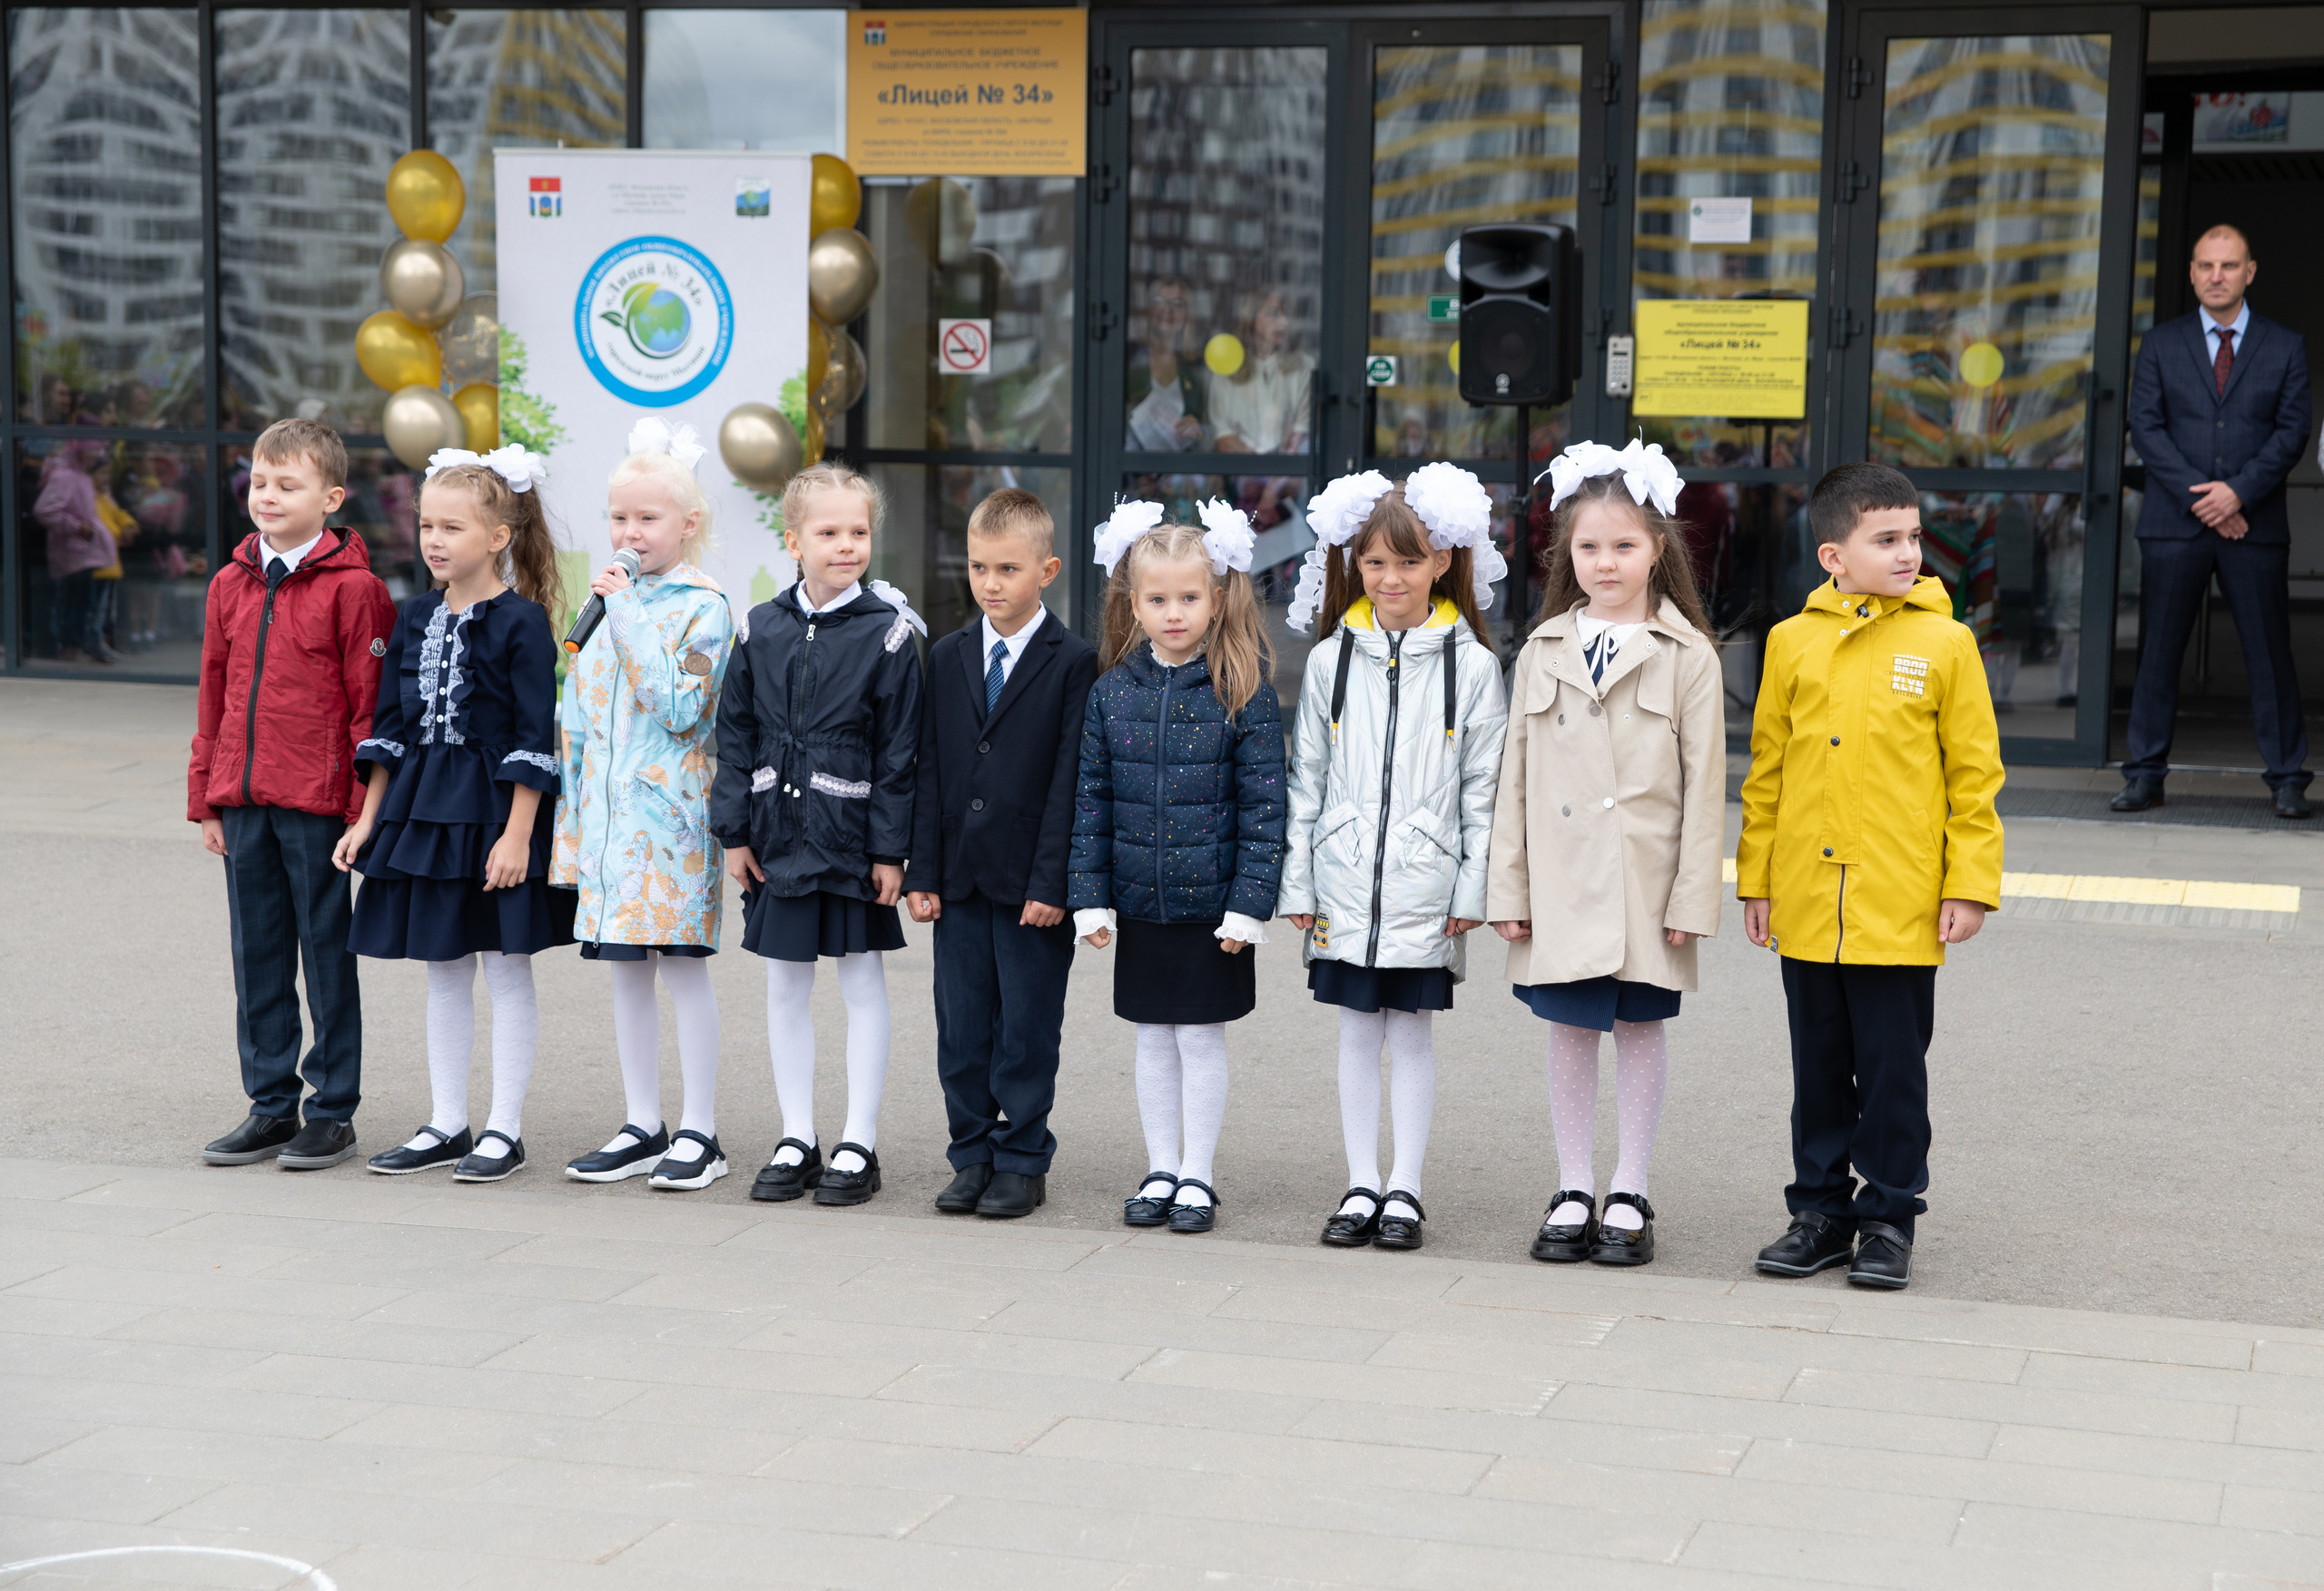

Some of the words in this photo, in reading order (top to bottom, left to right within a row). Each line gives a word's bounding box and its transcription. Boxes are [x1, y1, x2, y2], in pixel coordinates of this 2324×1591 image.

[877, 83, 969, 108] «Лицей
[977, 83, 1005, 105] №
[1012, 83, 1054, 104] 34»
[606, 260, 656, 307] «Лицей
[682, 276, 703, 307] 34»
[1679, 339, 1723, 349] «Лицей
[1742, 339, 1761, 349] 34»
[1894, 658, 1927, 677] BROO
[1892, 674, 1925, 694] KLYN
[1892, 690, 1922, 700] EXCLUSIVE
